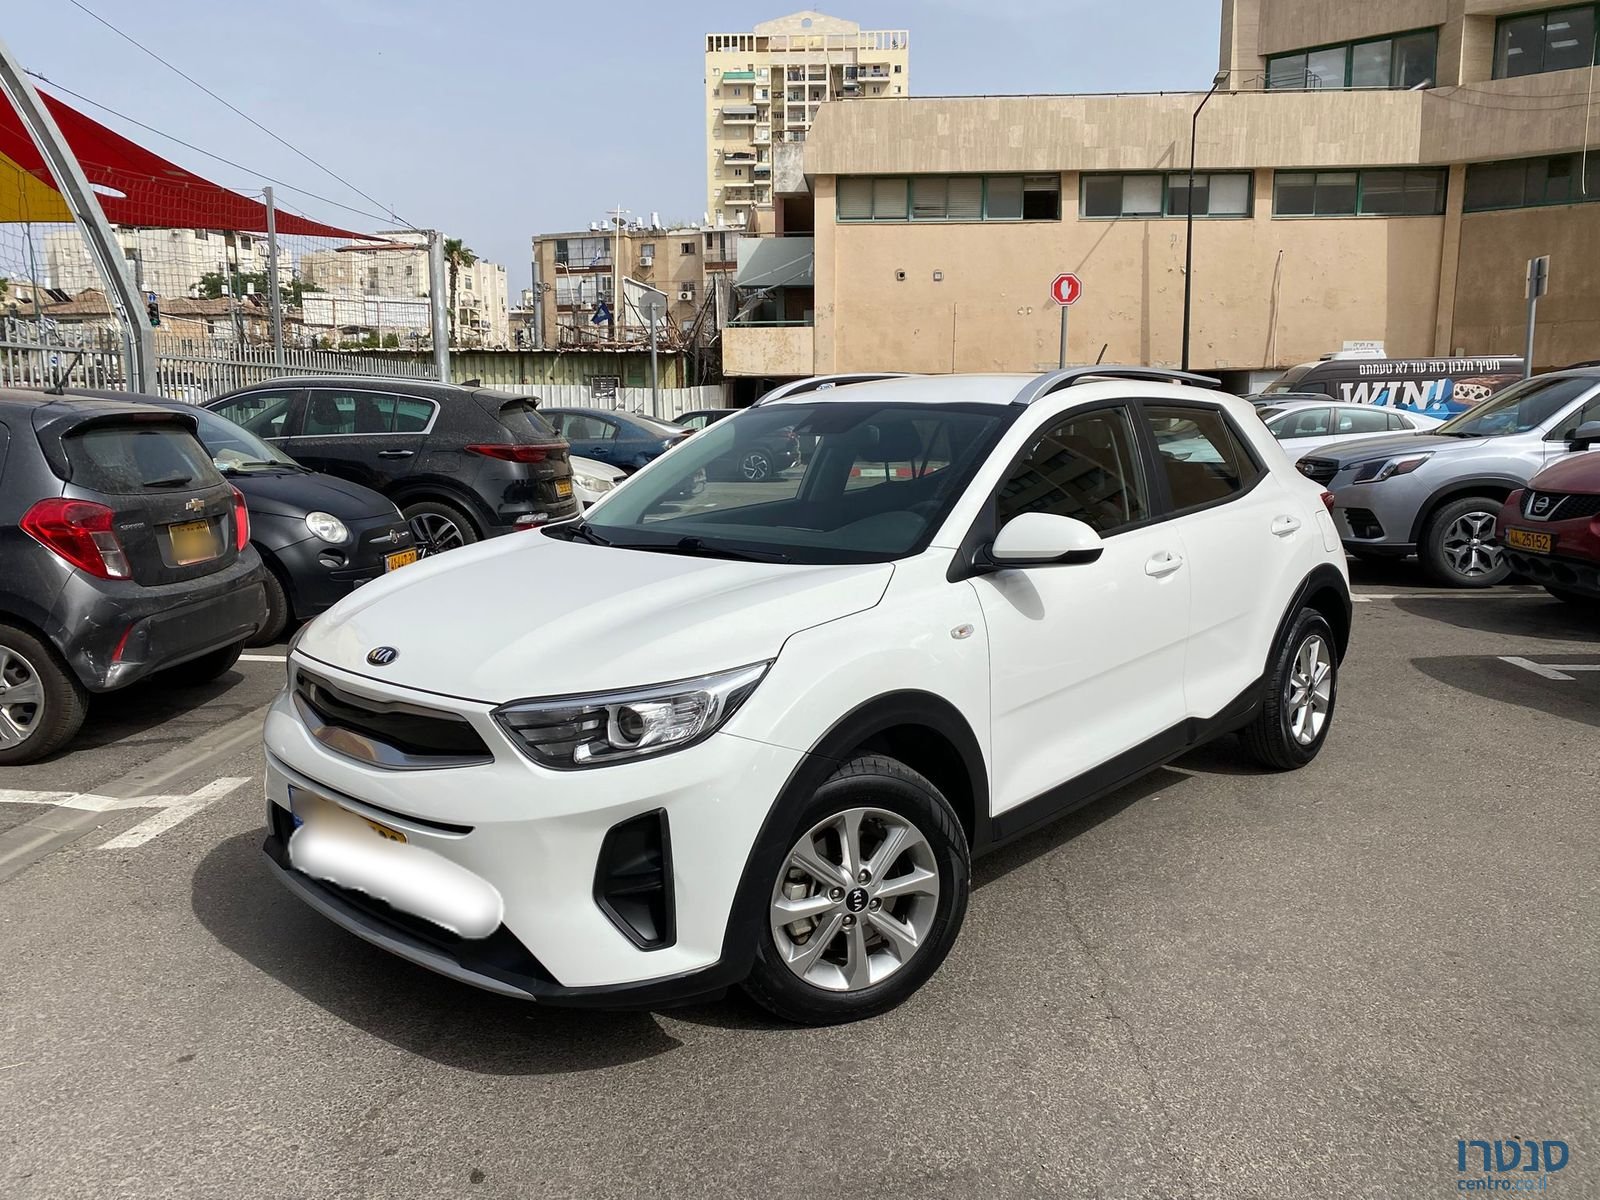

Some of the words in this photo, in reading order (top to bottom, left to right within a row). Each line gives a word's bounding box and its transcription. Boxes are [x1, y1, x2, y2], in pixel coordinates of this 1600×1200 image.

[1360, 363, 1392, 375] טעמתם
[1396, 361, 1408, 374] לא
[1411, 362, 1427, 373] עוד
[1429, 361, 1446, 372] כזה
[1449, 360, 1474, 374] חלבון
[1476, 360, 1500, 373] חטיף
[1341, 379, 1447, 410] WIN!
[369, 648, 393, 663] KIA
[853, 890, 862, 911] KIA
